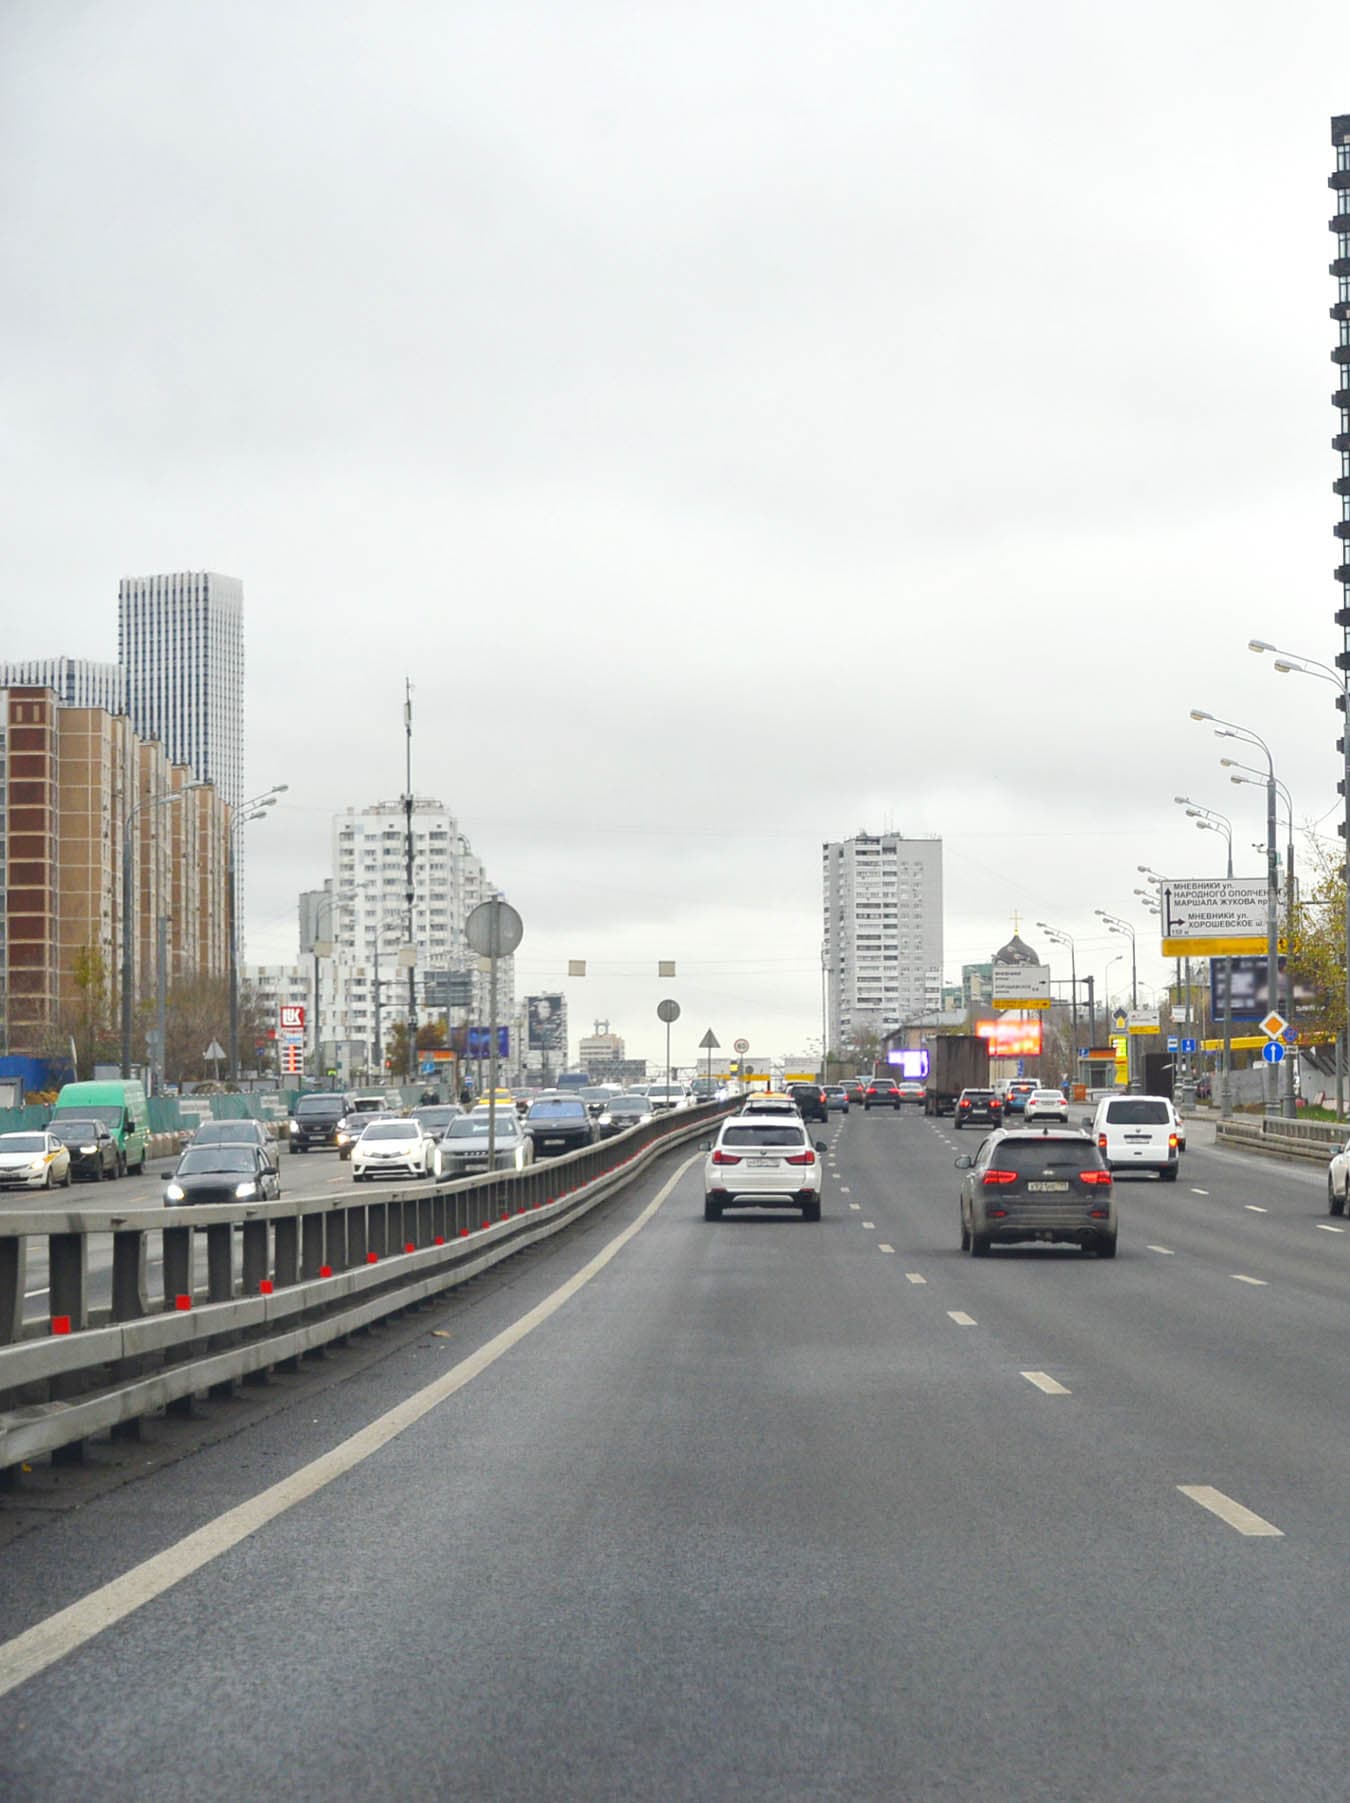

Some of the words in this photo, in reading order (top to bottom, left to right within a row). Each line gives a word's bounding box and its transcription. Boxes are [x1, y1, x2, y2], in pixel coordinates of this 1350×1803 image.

[1173, 882, 1220, 890] МНЕВНИКИ
[1173, 890, 1226, 899] НАРОДНОГО
[1174, 898, 1218, 907] МАРШАЛА
[1219, 898, 1255, 906] ЖУКОВА
[1188, 912, 1236, 920] МНЕВНИКИ
[1188, 920, 1253, 928] ХОРОШЕВСКОЕ
